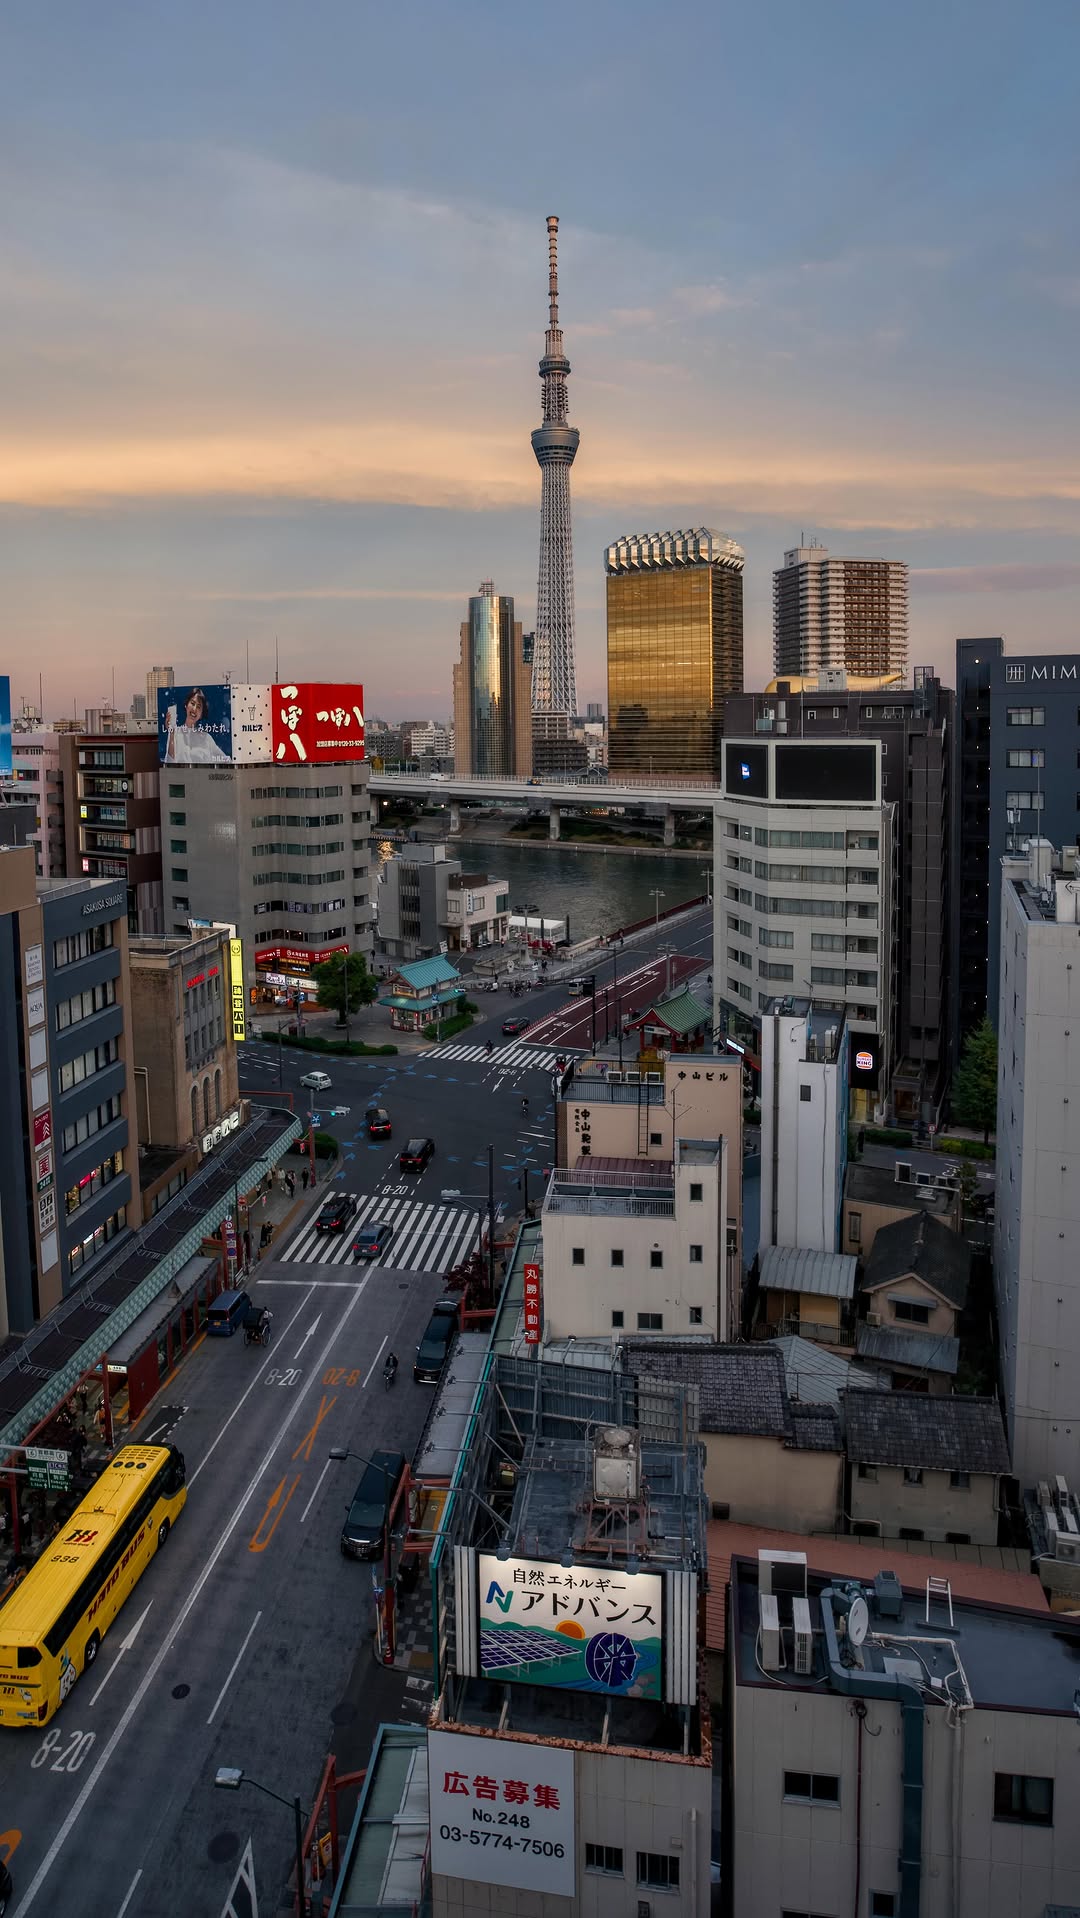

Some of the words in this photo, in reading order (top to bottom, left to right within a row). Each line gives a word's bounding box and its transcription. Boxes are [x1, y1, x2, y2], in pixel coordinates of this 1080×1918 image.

[1031, 665, 1077, 680] MIM
[241, 724, 263, 733] カルピス
[276, 686, 307, 761] つぼ八
[316, 706, 364, 730] つぼ八
[677, 1070, 728, 1082] 中山ビル
[381, 1184, 409, 1195] 8-20
[264, 1368, 303, 1386] 8-20
[512, 1567, 627, 1592] 自然エネルギー
[521, 1590, 657, 1625] アドバンス
[31, 1728, 97, 1772] 8-20
[443, 1770, 561, 1811] 広告募集
[472, 1807, 531, 1829] No.248
[440, 1824, 565, 1859] 03-5774-7506
